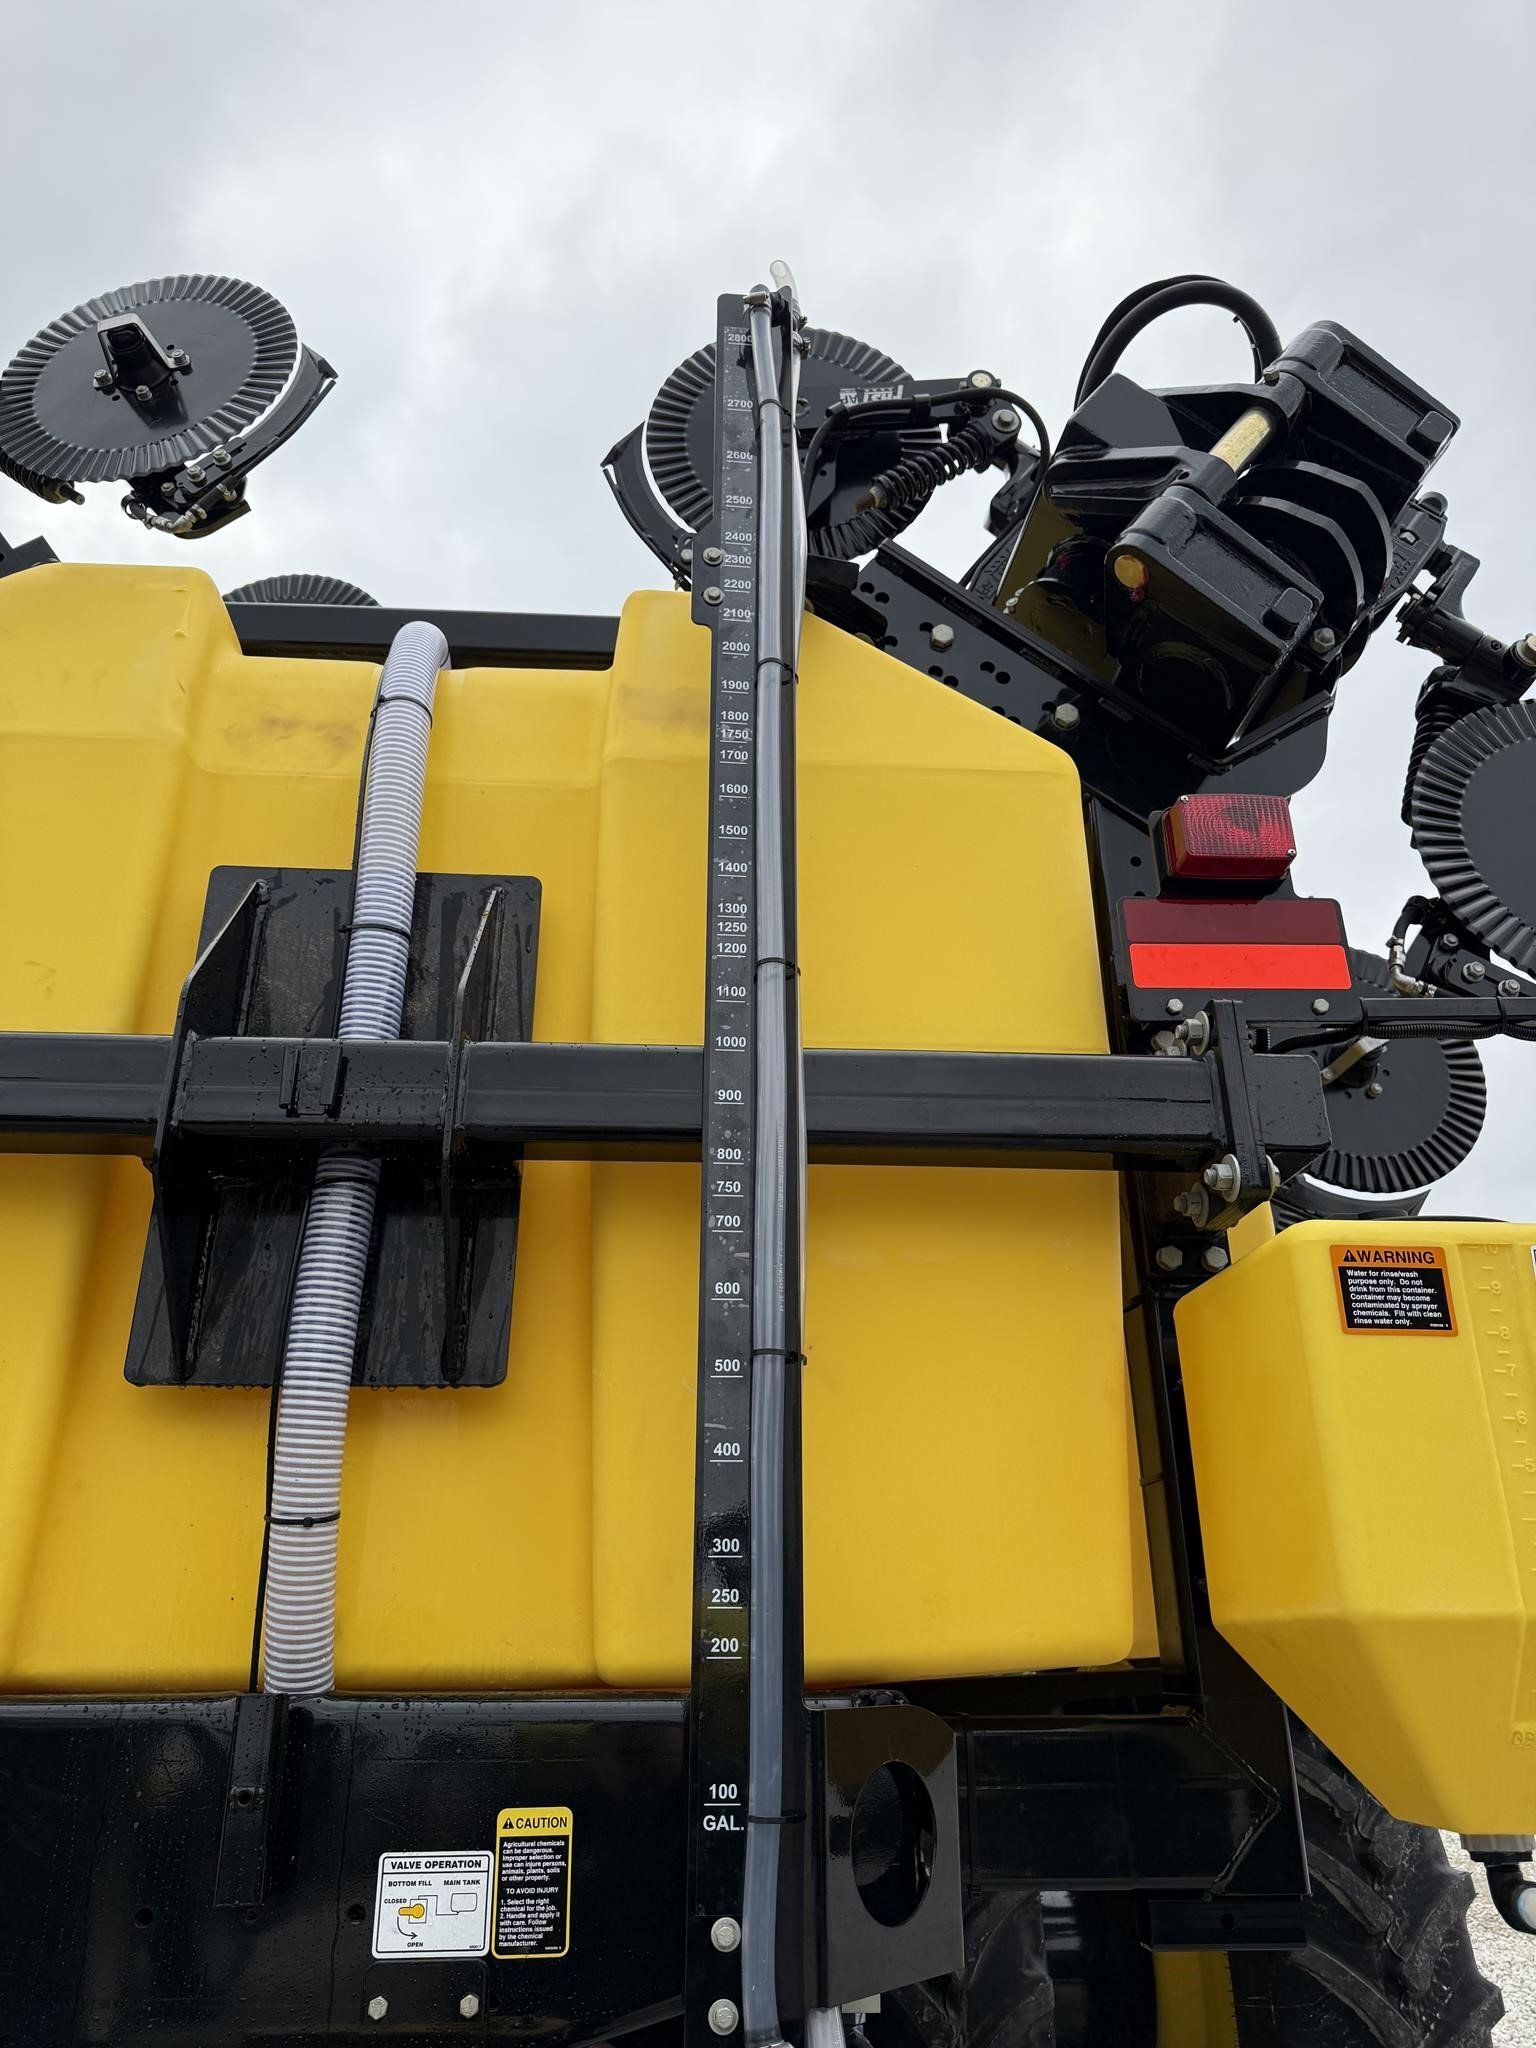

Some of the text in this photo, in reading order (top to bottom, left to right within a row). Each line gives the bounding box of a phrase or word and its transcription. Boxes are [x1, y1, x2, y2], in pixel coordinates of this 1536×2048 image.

[728, 399, 753, 408] 2700
[727, 451, 752, 460] 2600
[726, 495, 752, 505] 2500
[725, 532, 752, 541] 2400
[725, 554, 752, 565] 2300
[724, 579, 751, 589] 2200
[723, 608, 751, 618] 2100
[722, 642, 750, 652] 2000
[722, 680, 750, 691] 1900
[721, 711, 749, 722] 1800
[721, 729, 749, 740] 1750
[720, 750, 748, 760] 1700
[720, 784, 748, 794] 1600
[719, 825, 748, 836] 1500
[719, 862, 747, 872] 1400
[718, 903, 747, 914] 1300
[717, 922, 747, 932] 1250
[717, 943, 746, 953] 1200
[717, 986, 746, 997] 1100
[716, 1036, 746, 1047] 1000
[718, 1090, 742, 1101] 900
[717, 1149, 741, 1160] 800
[717, 1181, 741, 1193] 750
[716, 1215, 740, 1227] 700
[1357, 1250, 1434, 1264] WARNING
[715, 1282, 740, 1294] 600
[1491, 1281, 1501, 1294] 9
[1500, 1326, 1511, 1340] 8
[715, 1359, 740, 1372] 500
[1506, 1364, 1516, 1377] 7
[1517, 1410, 1527, 1425] 6
[714, 1443, 740, 1456] 400
[712, 1538, 740, 1552] 300
[712, 1589, 739, 1603] 250
[711, 1638, 738, 1653] 200
[709, 1784, 738, 1799] 100
[516, 1817, 567, 1829] CAUTION
[703, 1815, 744, 1831] GAL.
[391, 1860, 481, 1870] VALVE OPERATION
[525, 1861, 541, 1869] injure
